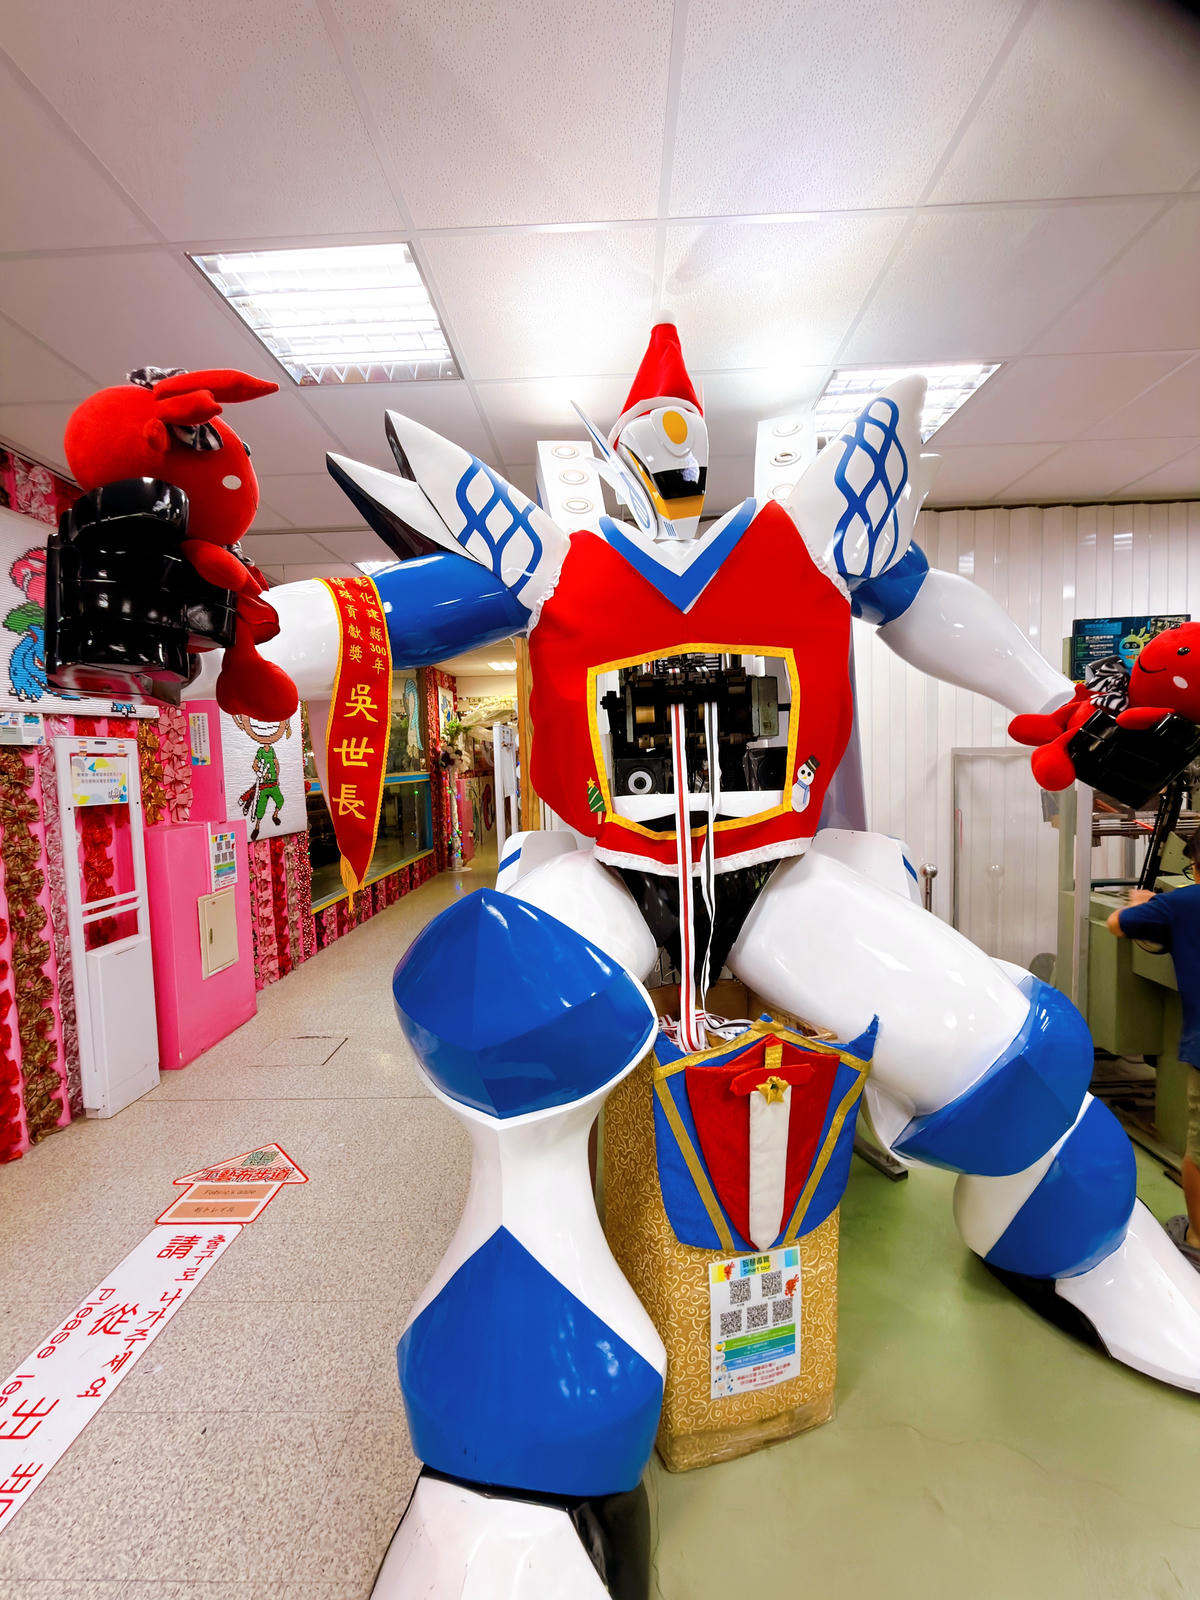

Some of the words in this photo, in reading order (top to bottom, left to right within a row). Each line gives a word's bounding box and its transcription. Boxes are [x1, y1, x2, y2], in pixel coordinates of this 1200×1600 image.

[353, 577, 387, 675] 彰化建縣300年
[332, 684, 379, 820] 吳世長
